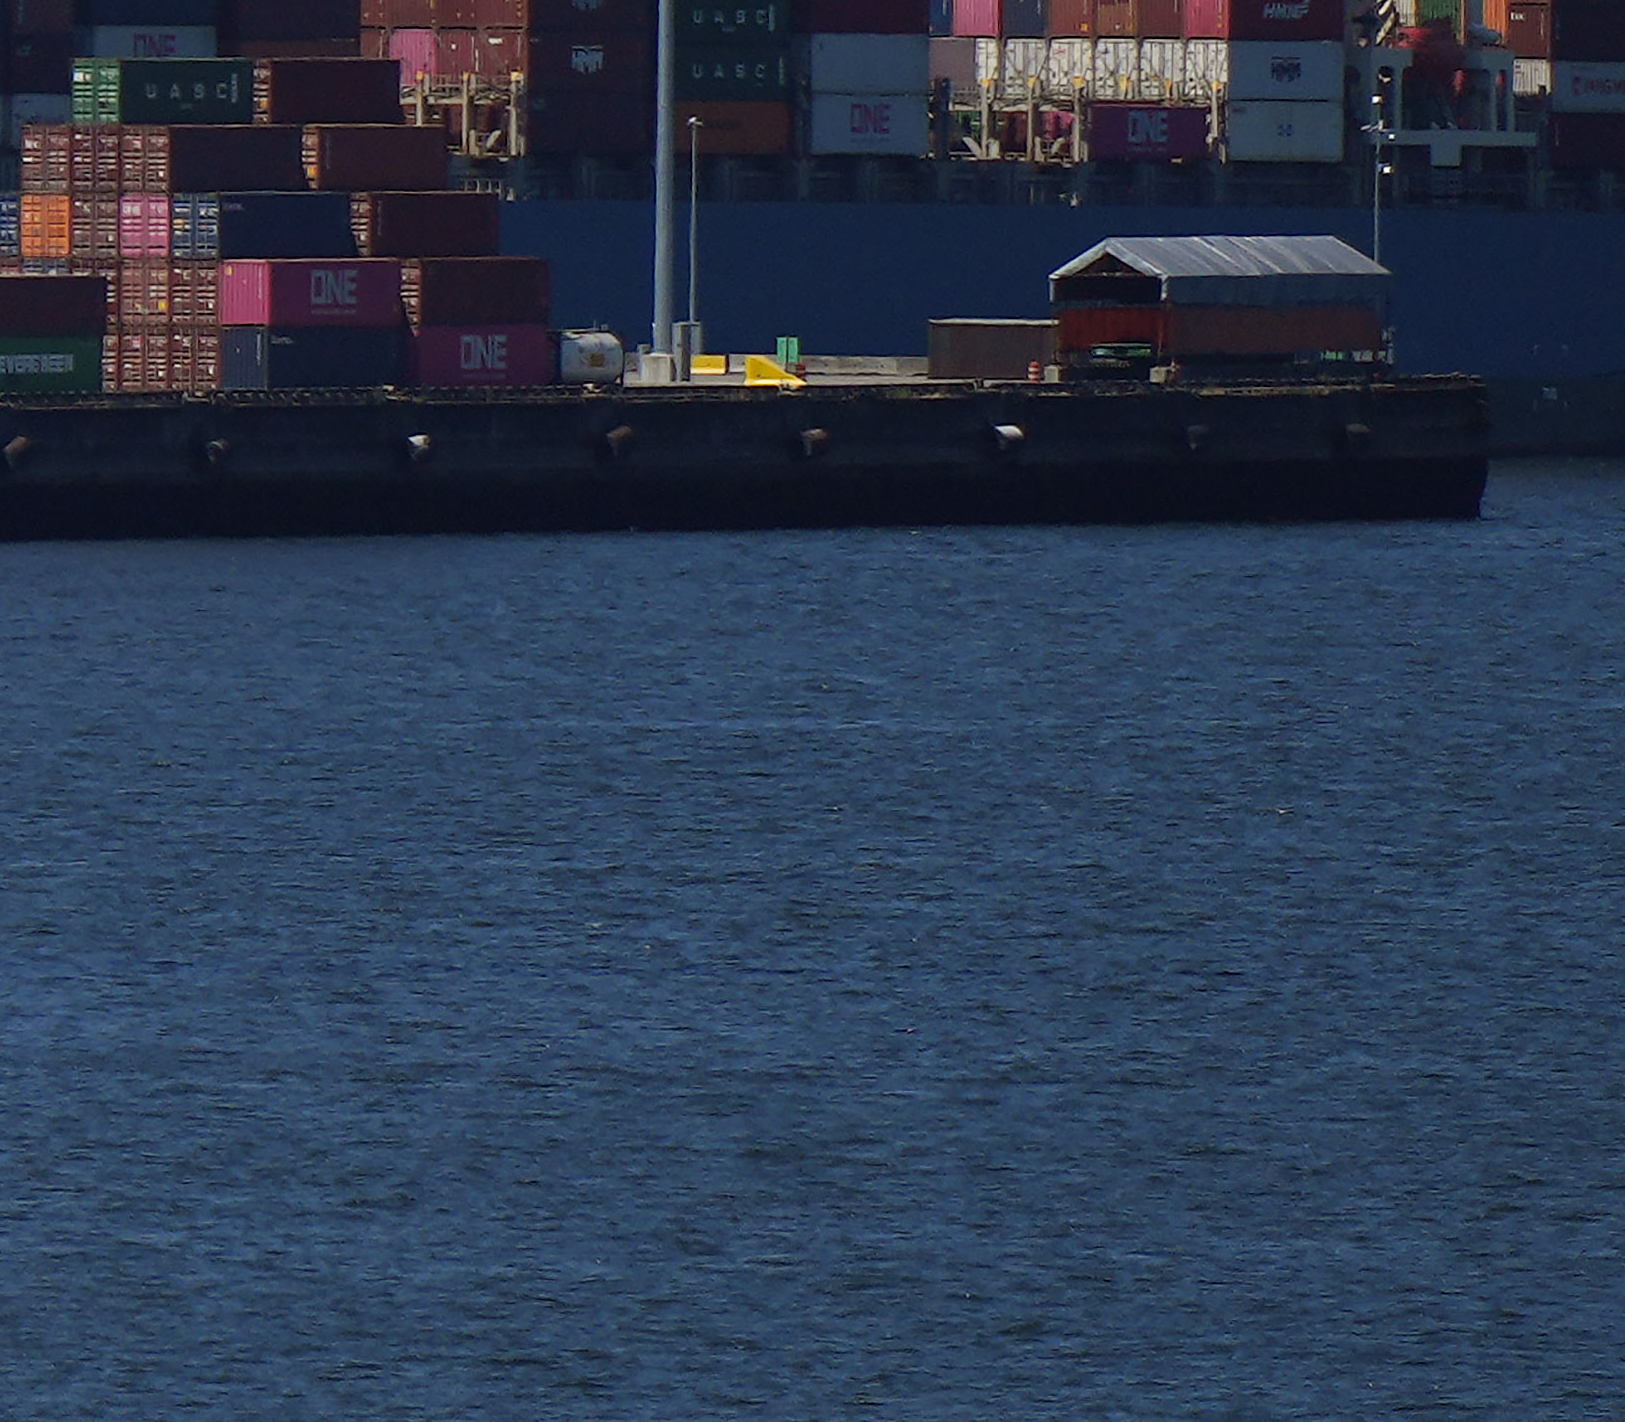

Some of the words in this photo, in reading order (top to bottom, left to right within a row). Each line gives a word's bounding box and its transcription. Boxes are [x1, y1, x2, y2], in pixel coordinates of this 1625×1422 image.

[692, 63, 765, 79] UASC
[145, 82, 227, 101] UASC
[850, 103, 891, 135] ONE
[1128, 110, 1170, 143] ONE
[311, 269, 358, 304] ONE
[460, 335, 507, 369] ONE
